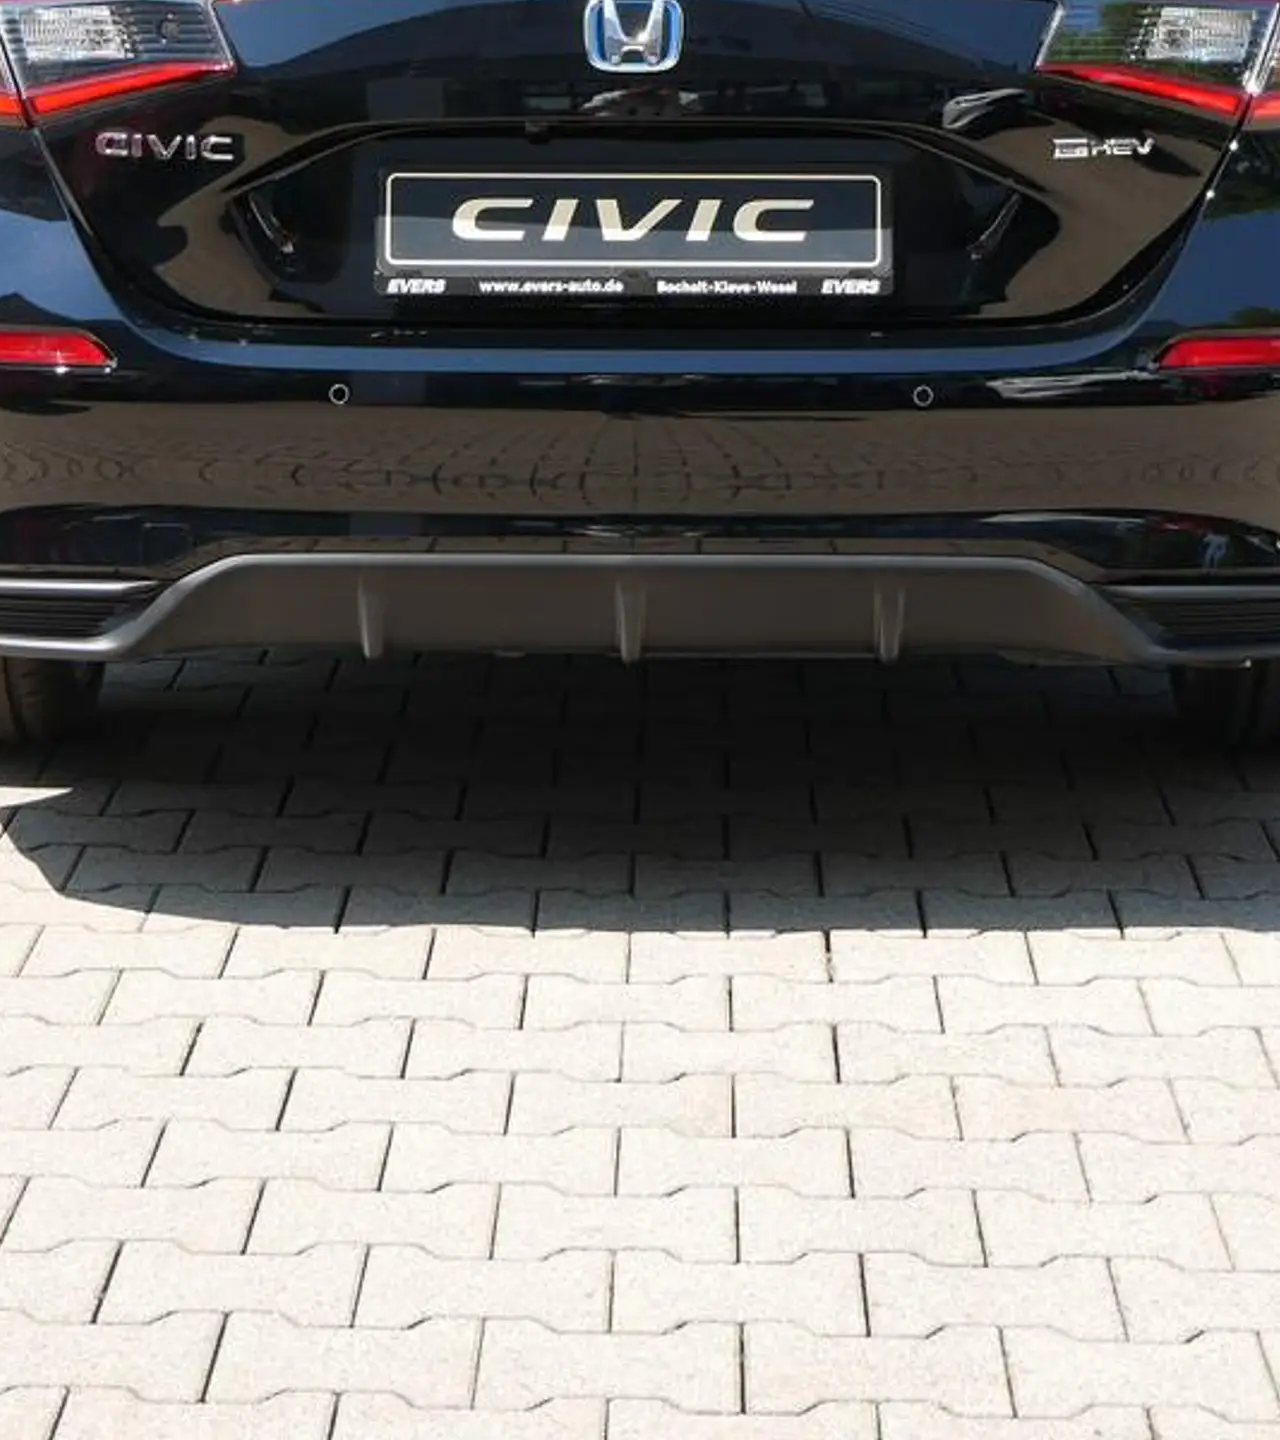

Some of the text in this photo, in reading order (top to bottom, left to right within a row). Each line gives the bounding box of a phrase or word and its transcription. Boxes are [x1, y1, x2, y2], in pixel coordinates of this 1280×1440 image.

[94, 131, 234, 161] CIVIC
[452, 198, 815, 242] CIVIC
[387, 278, 447, 294] EVERS
[478, 279, 625, 294] www.evers-auto.de
[821, 278, 881, 294] EVERS
